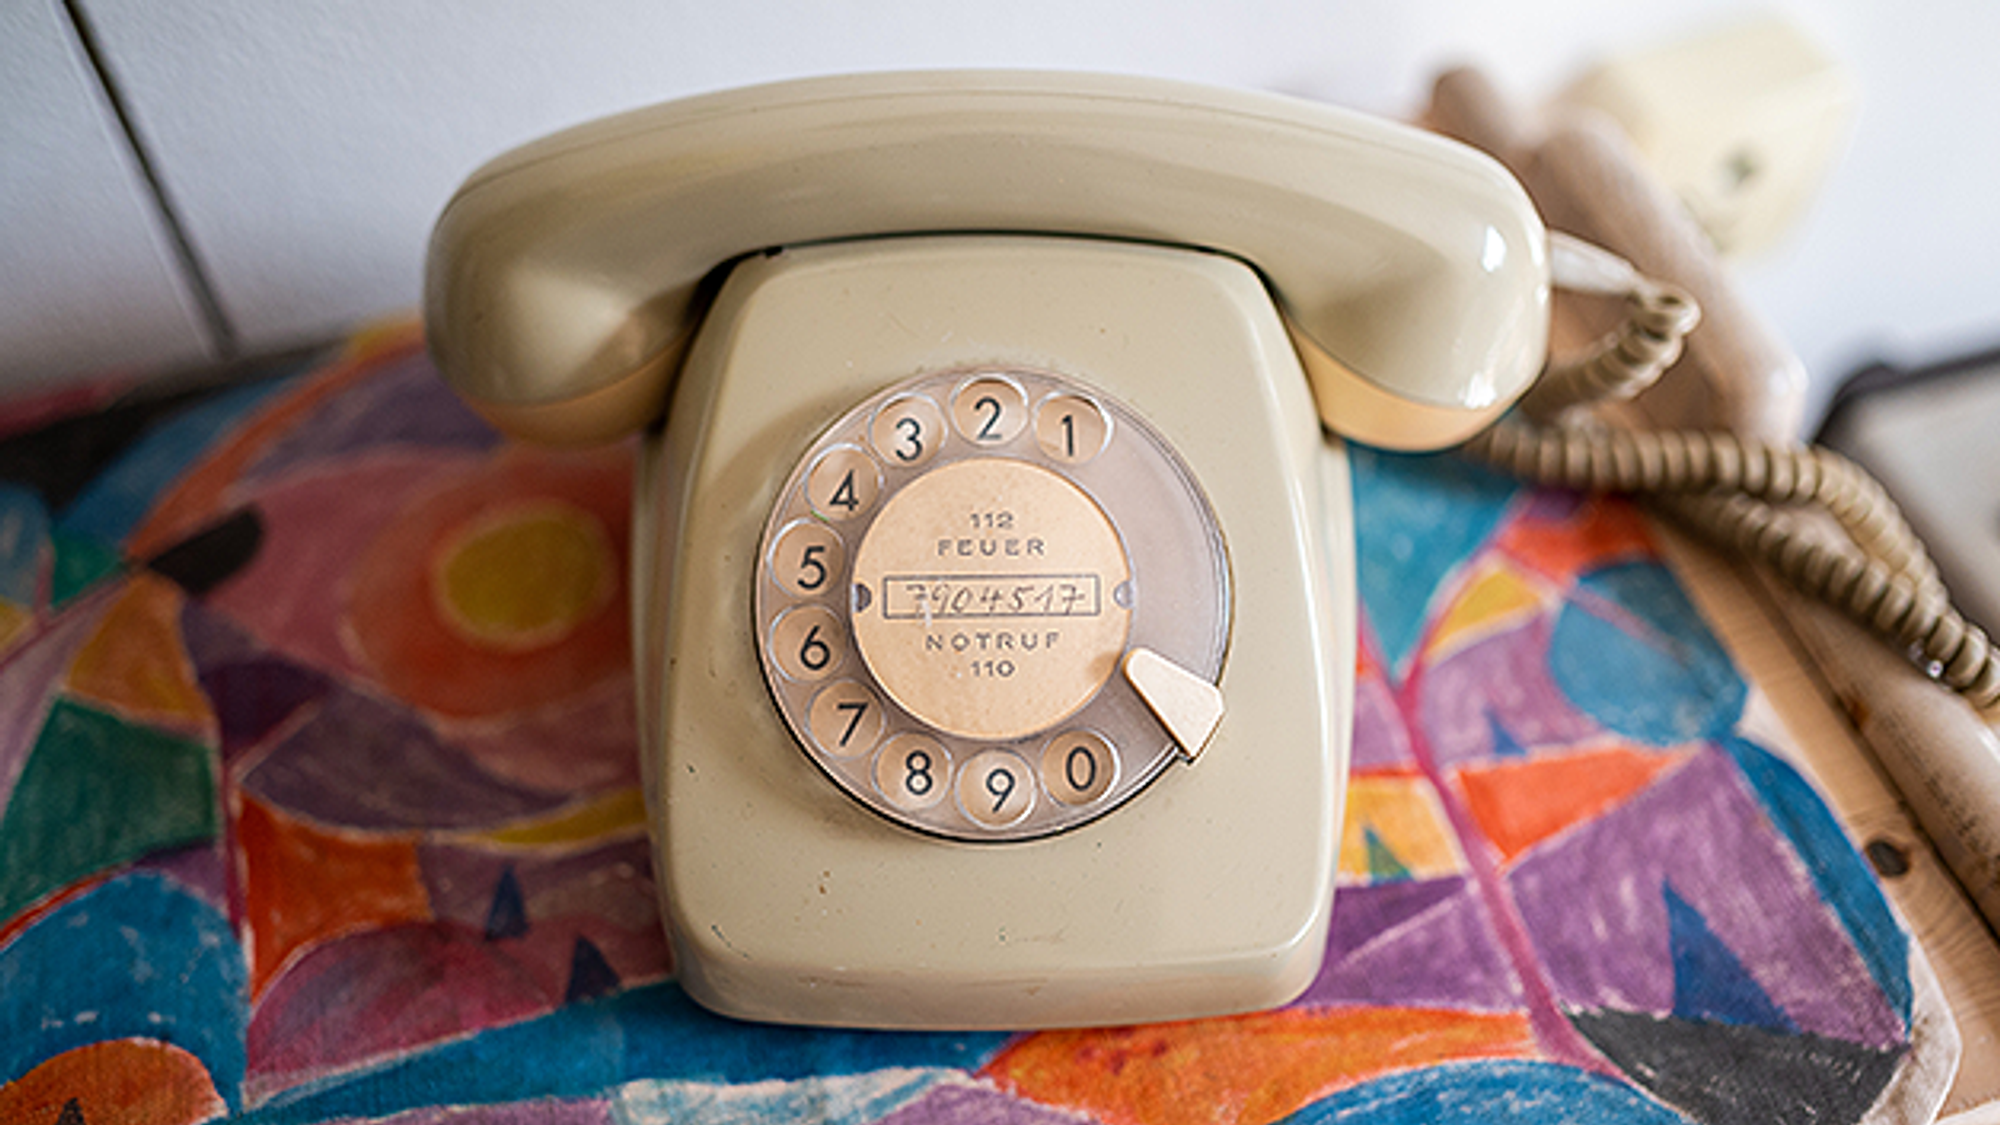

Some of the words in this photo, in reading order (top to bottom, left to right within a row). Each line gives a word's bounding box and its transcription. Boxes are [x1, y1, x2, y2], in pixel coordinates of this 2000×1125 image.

[895, 417, 923, 460] 3
[974, 398, 1001, 439] 2
[1060, 416, 1074, 457] 1
[829, 470, 859, 511] 4
[970, 512, 1014, 528] 112
[797, 546, 826, 590] 5
[937, 539, 1045, 556] FEUER
[906, 583, 1085, 616] 7904517
[799, 625, 831, 670] 6
[925, 632, 1060, 651] NOTRUF
[971, 661, 1015, 677] 110
[837, 702, 868, 746] 7
[904, 750, 933, 794] 8
[1066, 747, 1095, 791] 0
[985, 768, 1015, 813] 9
